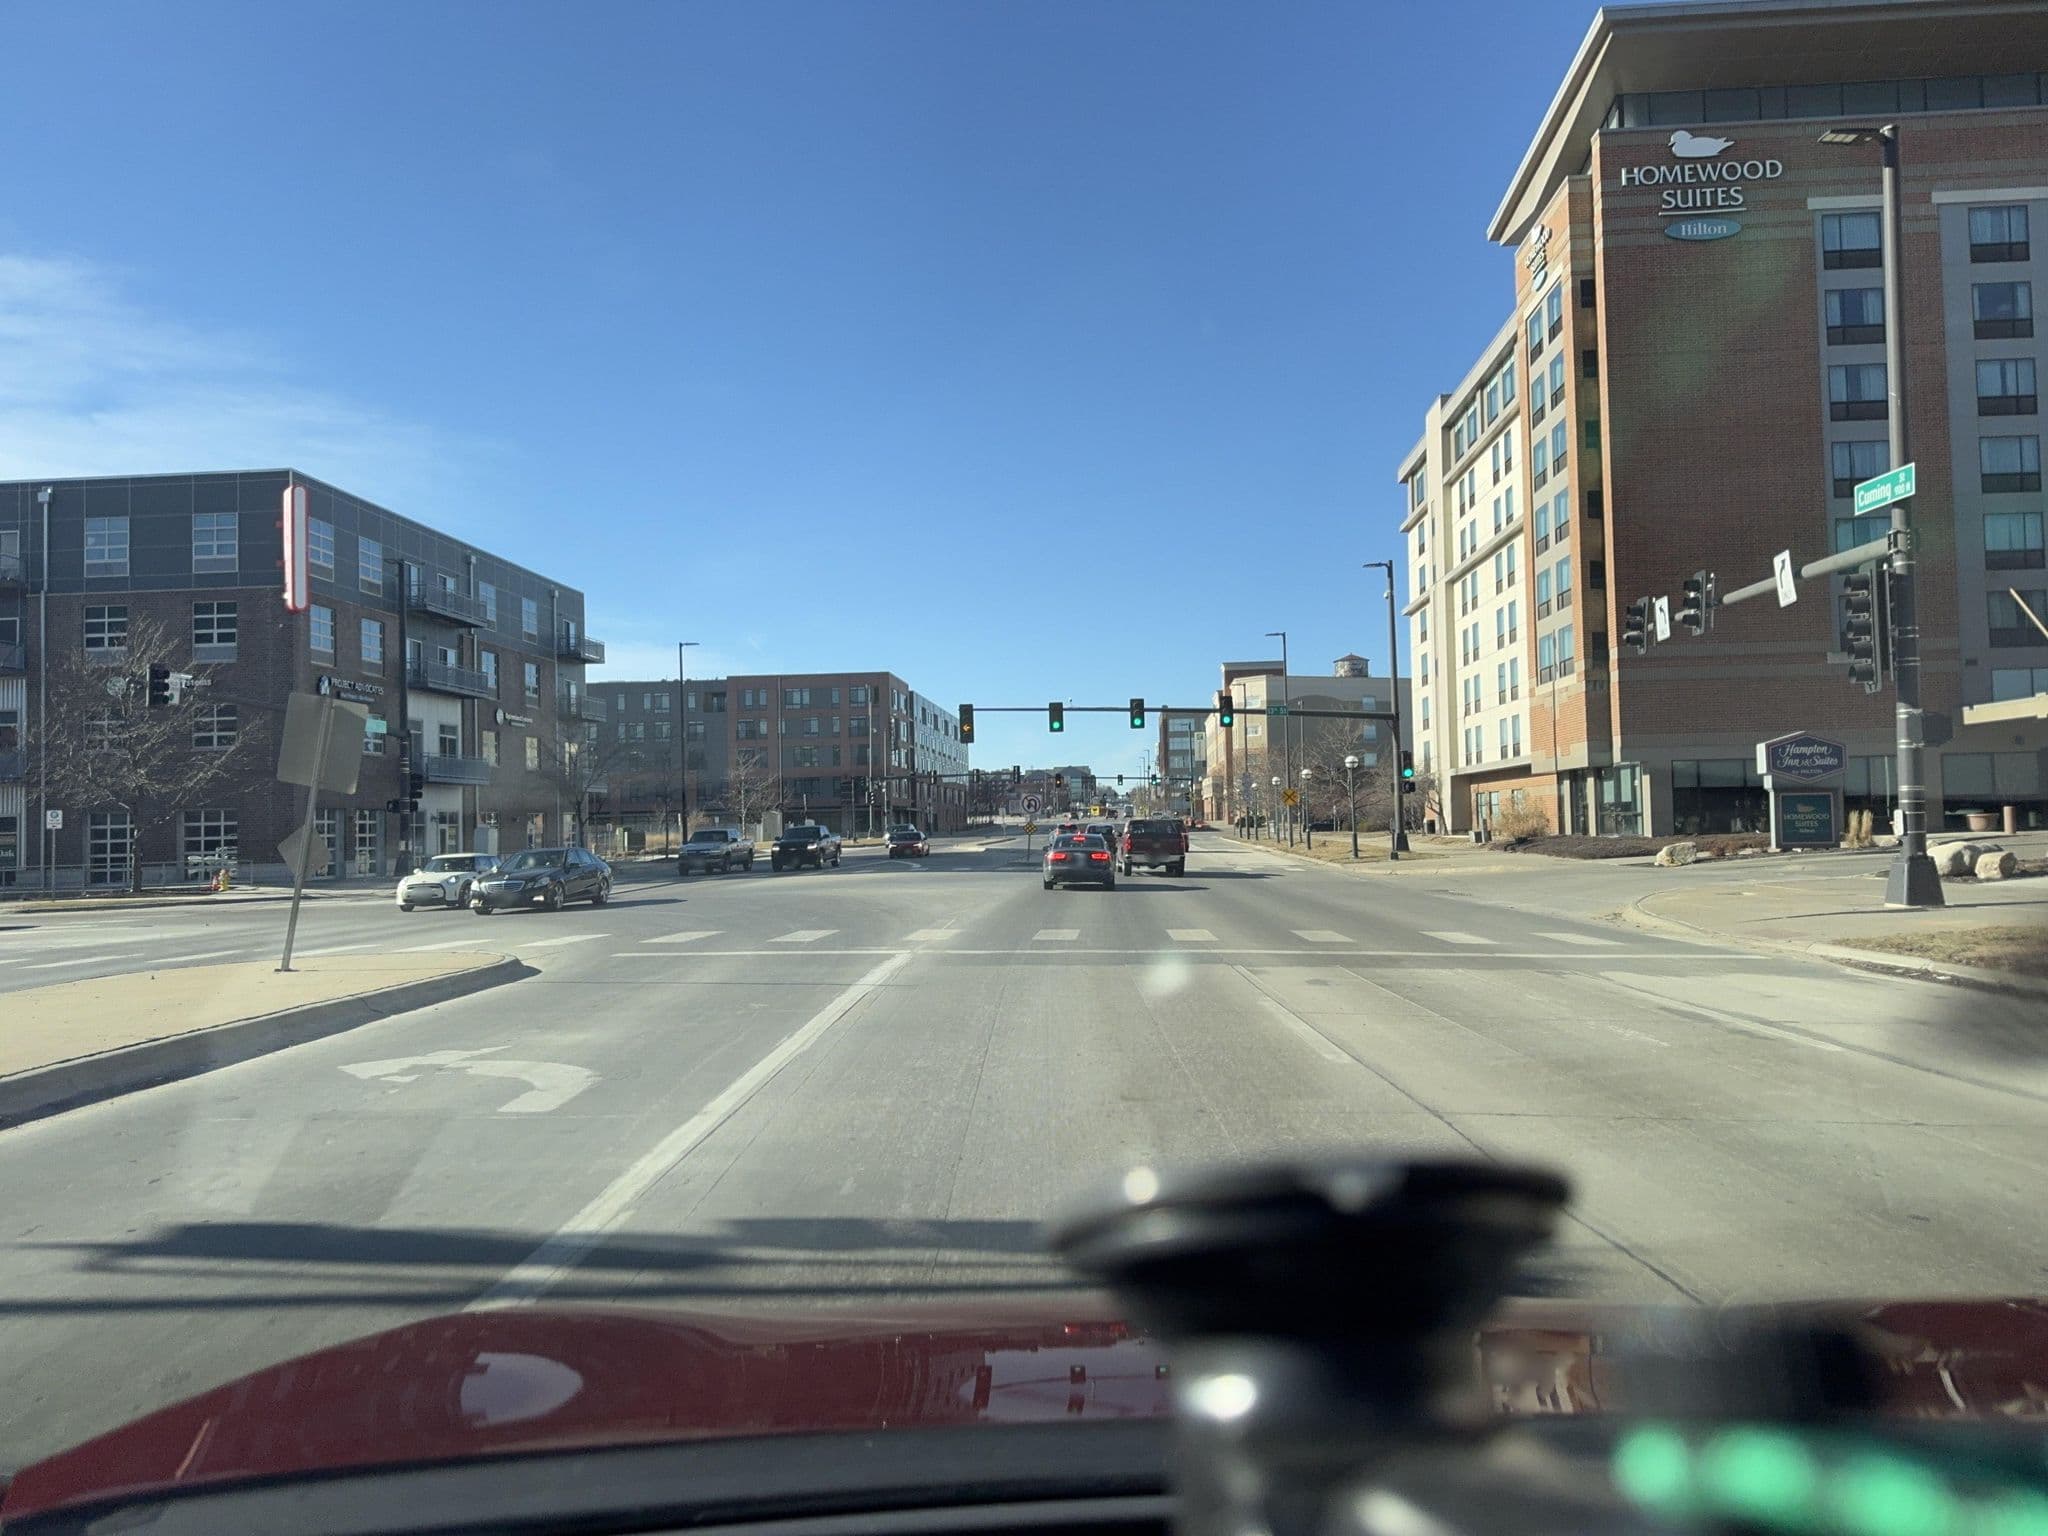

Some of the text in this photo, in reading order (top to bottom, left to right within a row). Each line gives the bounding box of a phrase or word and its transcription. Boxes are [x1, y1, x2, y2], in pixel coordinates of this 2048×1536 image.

[1621, 159, 1782, 186] HOMEWOOD
[1661, 186, 1744, 209] SUITES
[1680, 223, 1727, 236] Hilton
[1859, 483, 1891, 507] Cuming
[331, 677, 385, 695] PROJECT ADVOCATES
[1779, 744, 1833, 757] Hampton
[1777, 757, 1802, 768] Inn
[1810, 755, 1839, 767] Suites
